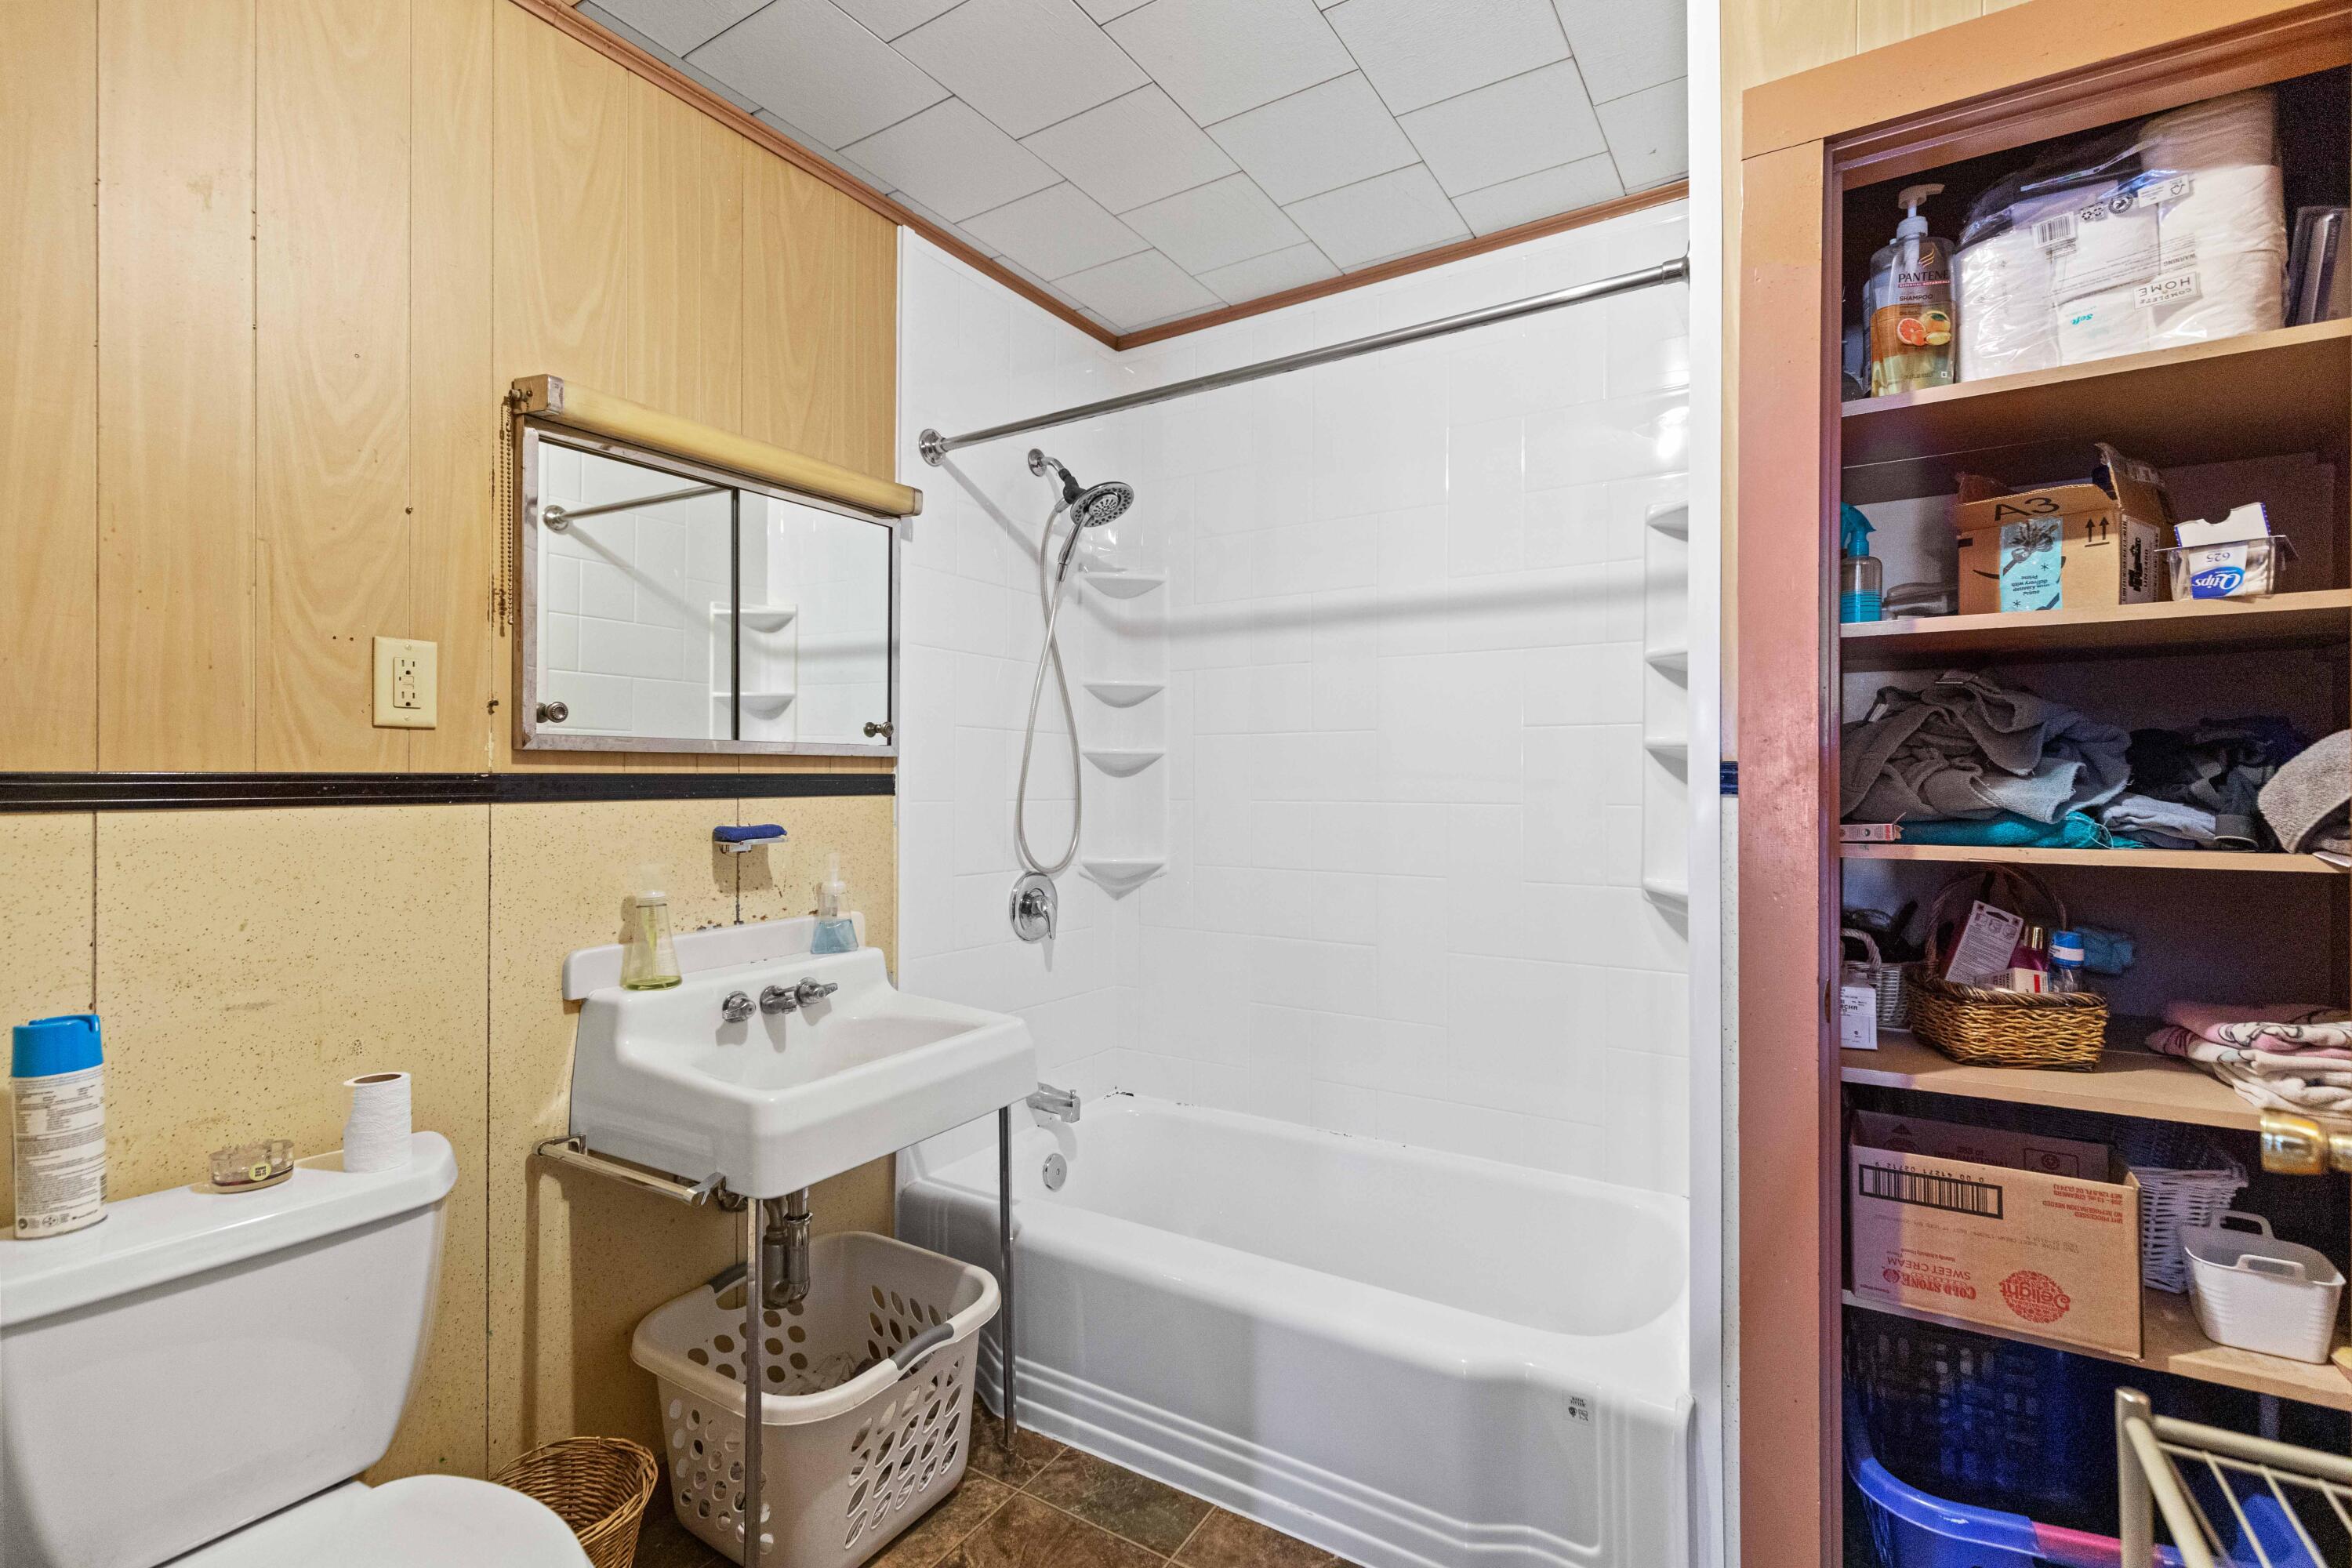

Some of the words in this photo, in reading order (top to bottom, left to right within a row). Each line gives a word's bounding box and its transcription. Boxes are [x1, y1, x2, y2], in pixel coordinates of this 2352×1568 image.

[2163, 253, 2197, 267] WARNING
[1898, 270, 1950, 284] PANTENE
[2138, 277, 2190, 296] HOME
[2139, 289, 2192, 304] COMPLETE
[2071, 314, 2093, 325] Soft
[1994, 497, 2060, 521] A3
[2206, 552, 2230, 563] 625
[1886, 1163, 1915, 1173] 02712
[1922, 1169, 1952, 1178] 41271
[2053, 1190, 2086, 1200] CREAMERS
[2042, 1200, 2066, 1209] NEEDED
[2074, 1212, 2109, 1223] PROCESSED
[1886, 1257, 1929, 1272] CREAM
[1932, 1265, 1971, 1280] SWEET
[1901, 1272, 1941, 1293] STONE
[1944, 1282, 1976, 1301] COLD
[1999, 1280, 2071, 1311] Delight
